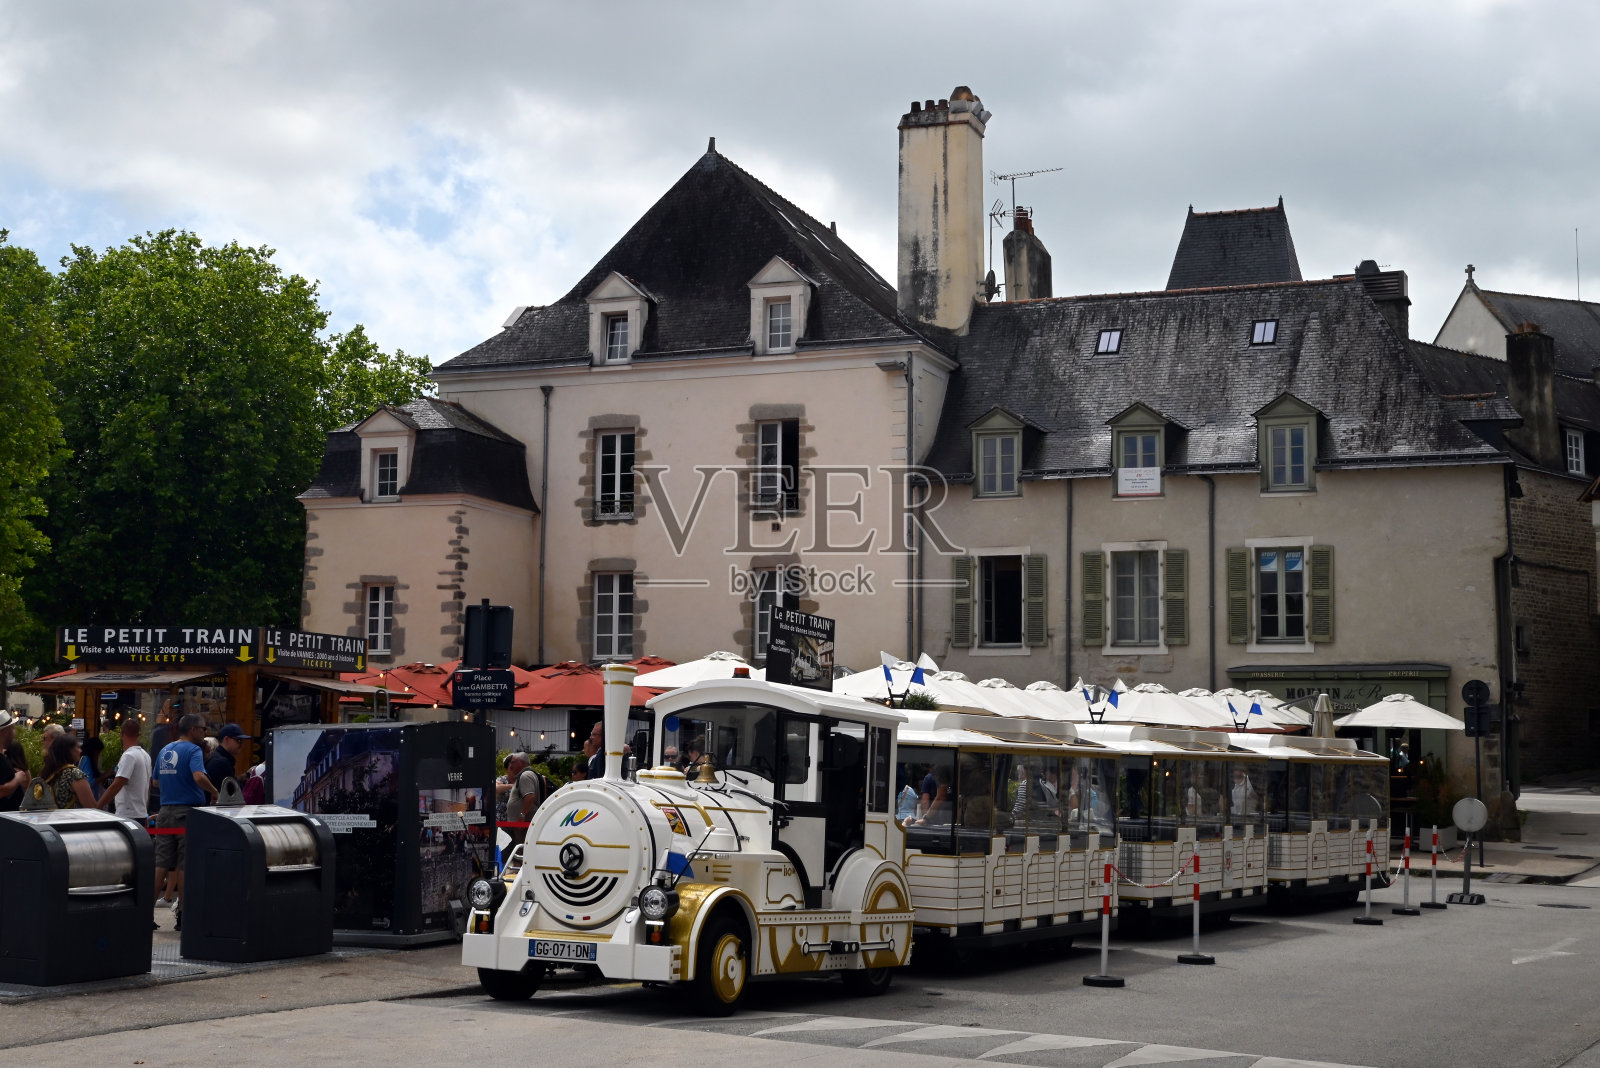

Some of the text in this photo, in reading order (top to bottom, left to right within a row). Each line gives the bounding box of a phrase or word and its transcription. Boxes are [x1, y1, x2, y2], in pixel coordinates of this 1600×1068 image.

[774, 608, 830, 631] Le PETIT TRAIN
[795, 626, 808, 635] Vannes
[64, 629, 252, 644] LE PETIT TRAIN
[266, 630, 364, 654] LE PETIT TRAIN
[80, 645, 102, 654] Visite
[105, 646, 115, 654] de
[159, 646, 179, 654] 2000
[195, 646, 234, 654] d'histoire
[277, 648, 290, 657] Visite
[296, 650, 314, 659] VANNES
[316, 652, 328, 660] 2000
[130, 654, 185, 662] TICKETS
[302, 658, 332, 669] TICKETS
[1344, 689, 1355, 699] du
[447, 772, 463, 781] VERRE
[536, 942, 589, 958] GG-071-DN
